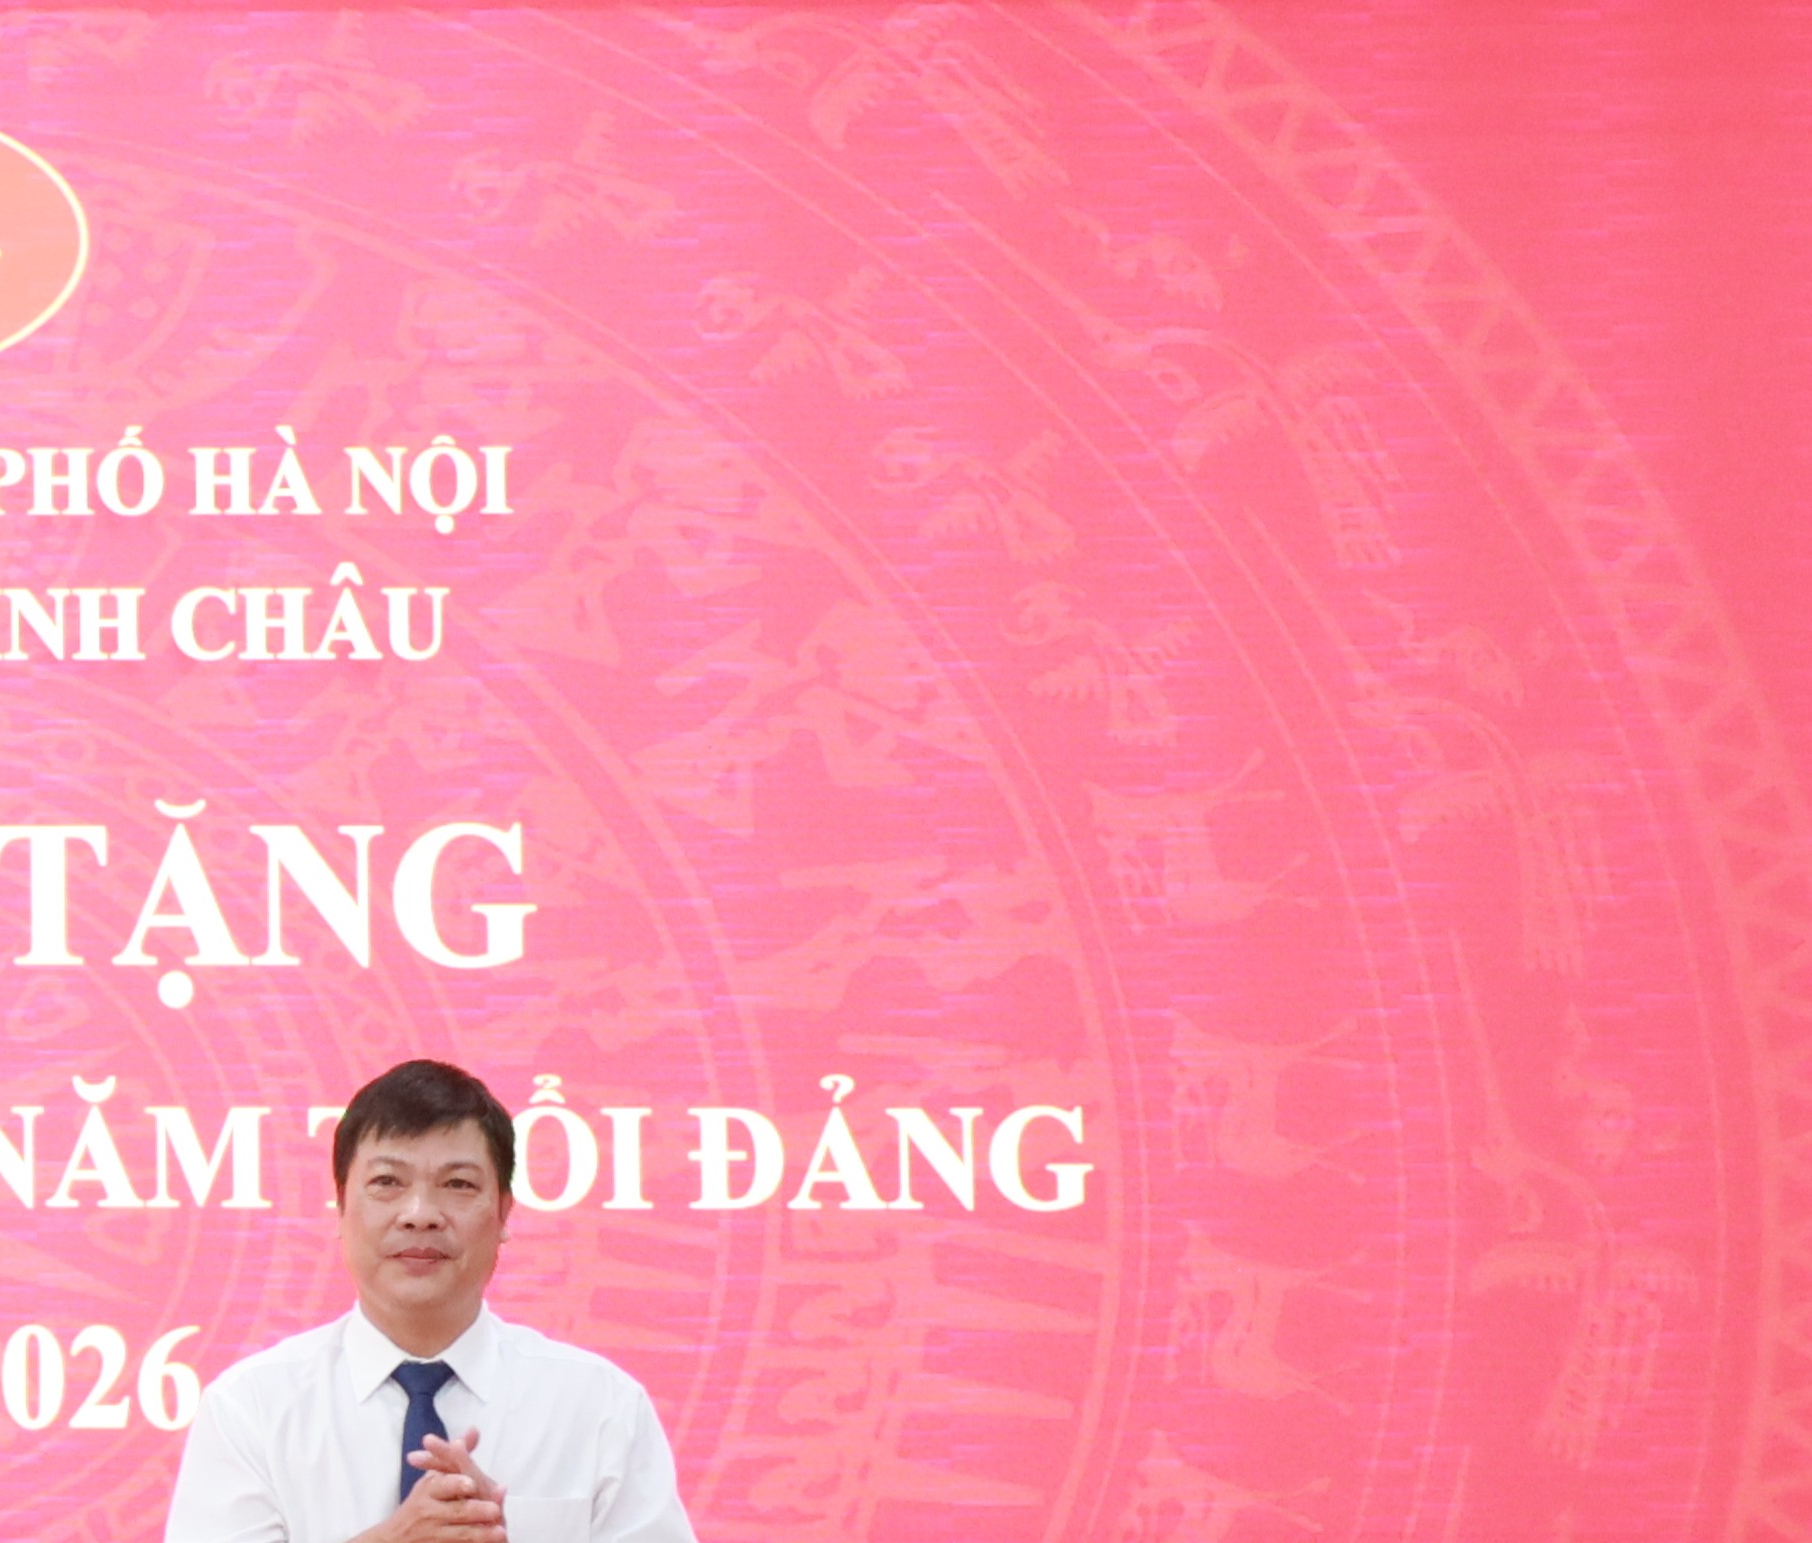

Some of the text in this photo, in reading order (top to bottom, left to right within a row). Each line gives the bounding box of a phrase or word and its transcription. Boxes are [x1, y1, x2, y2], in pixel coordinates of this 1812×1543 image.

[190, 425, 321, 516] HÀ
[345, 434, 513, 535] NỘI
[170, 561, 451, 662] CHÂU
[307, 1074, 653, 1212] ỔI
[687, 1074, 1093, 1212] ĐẢNG
